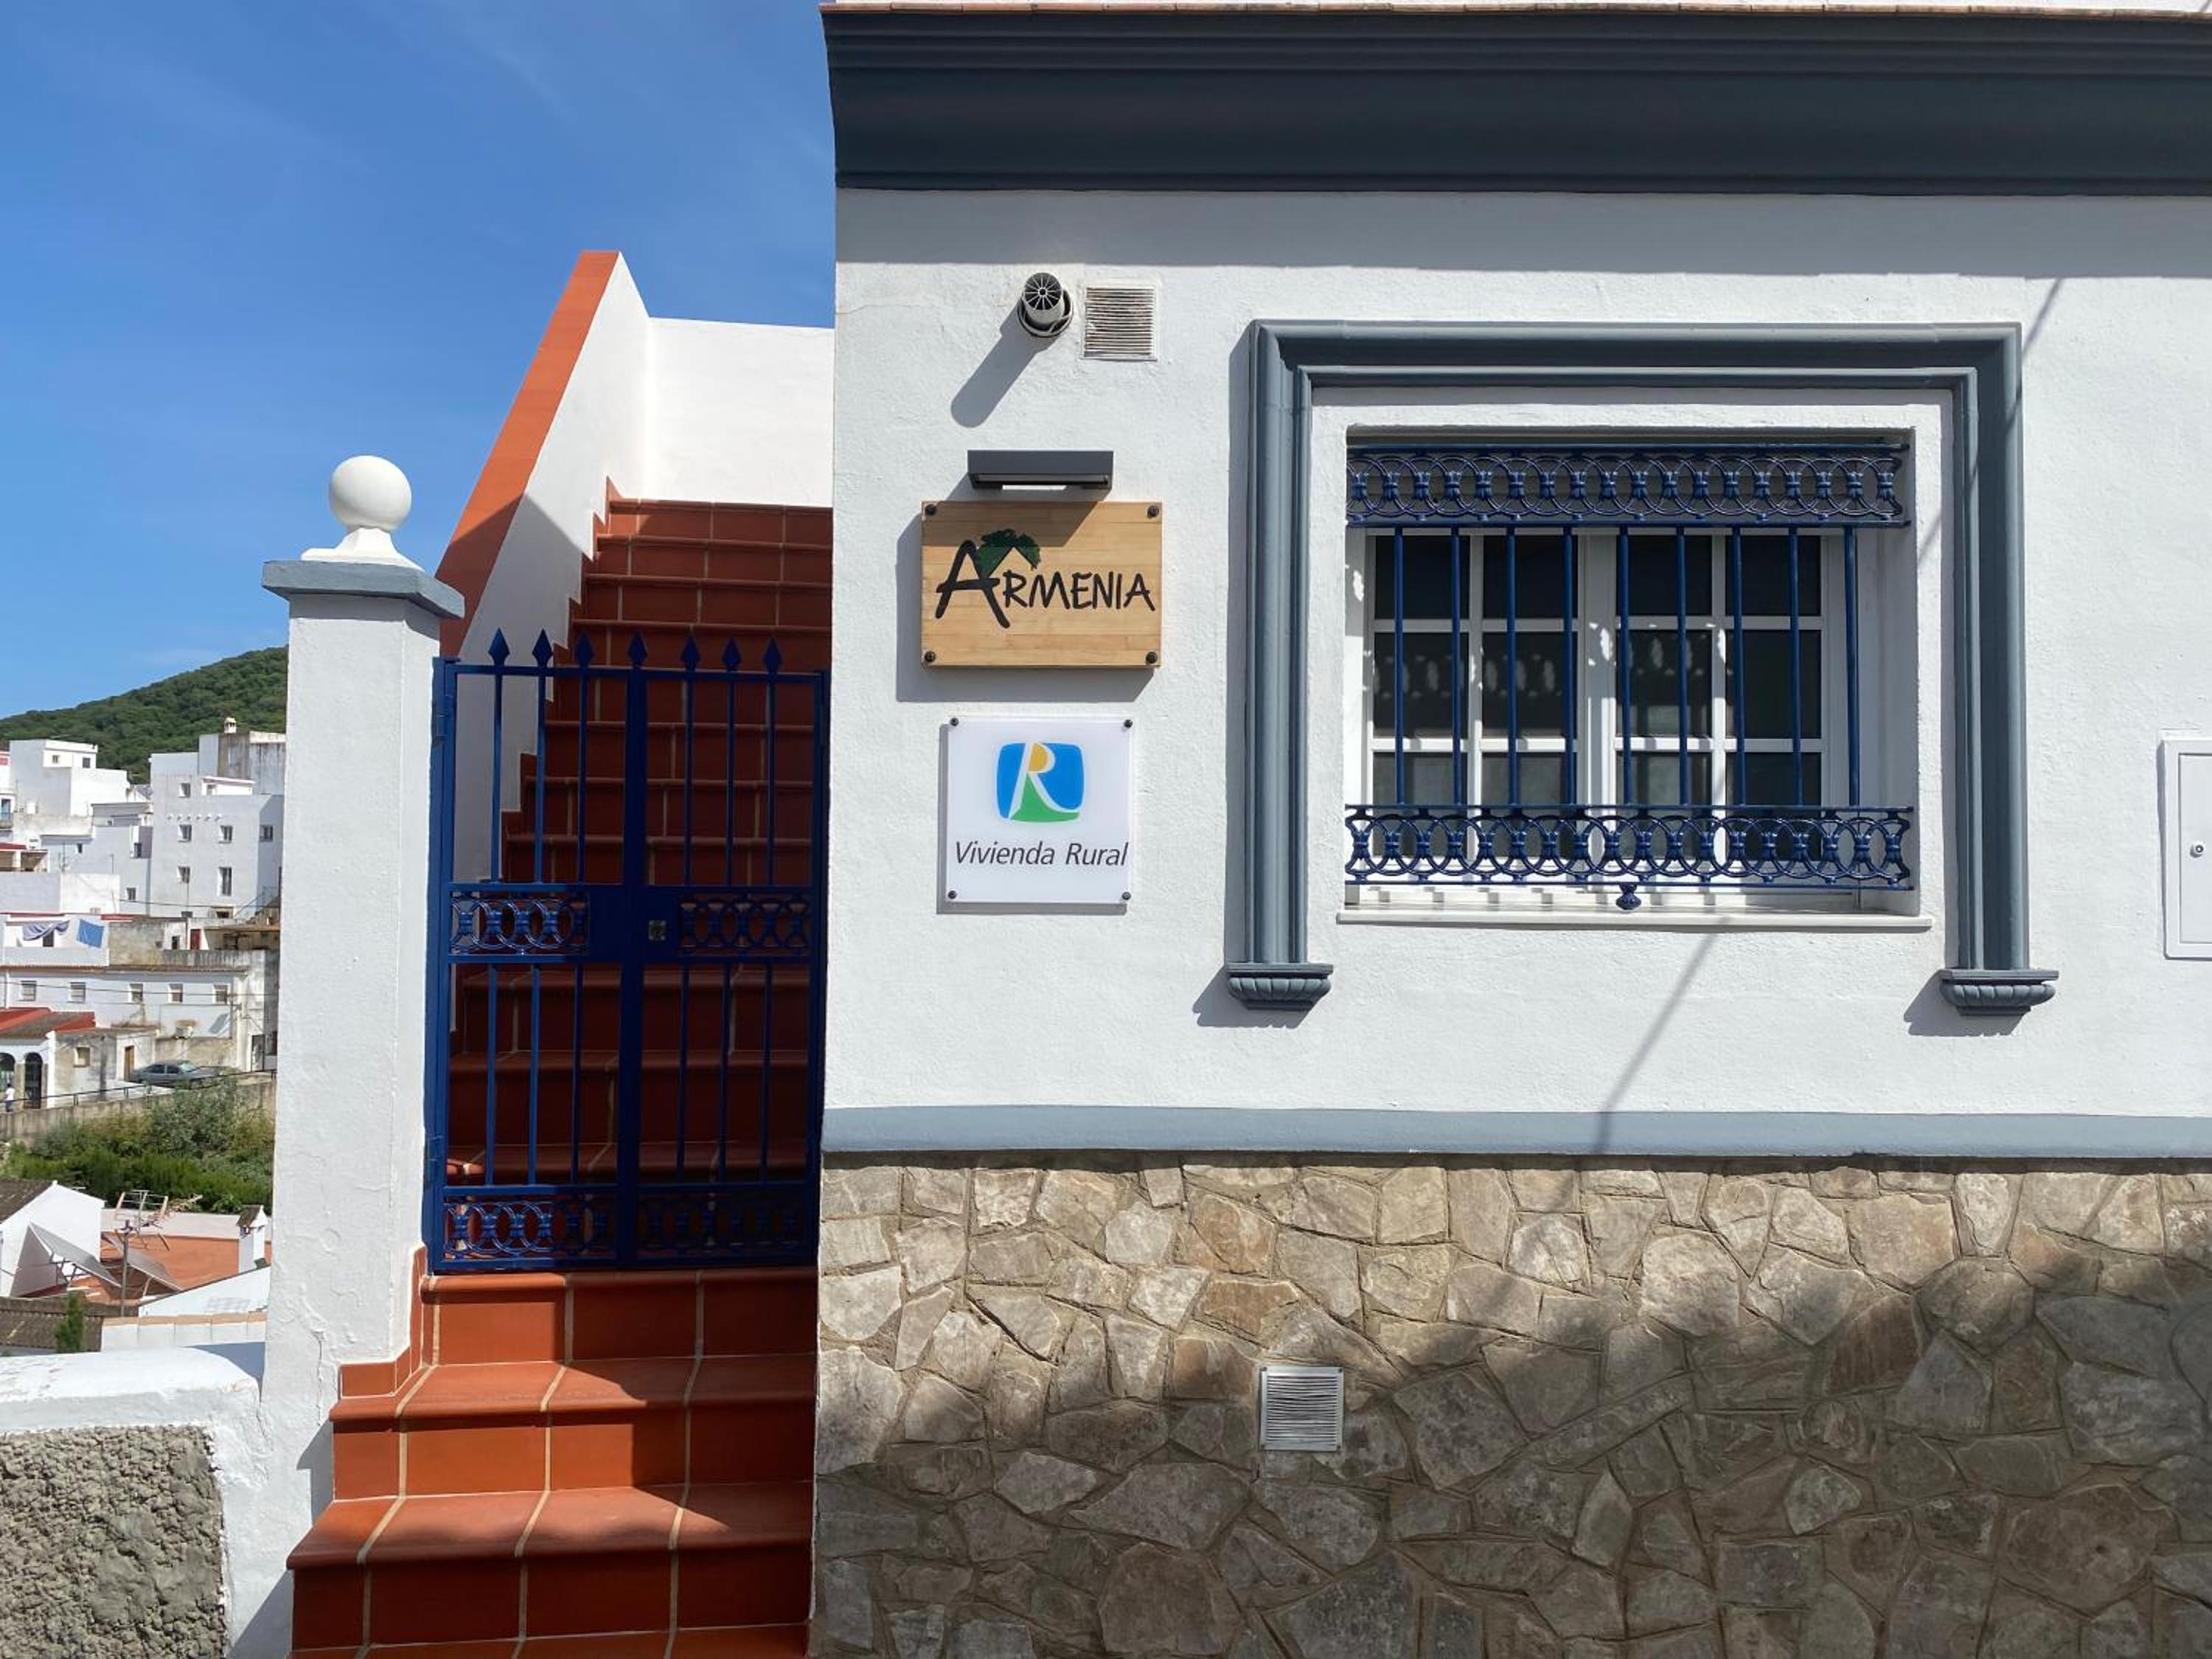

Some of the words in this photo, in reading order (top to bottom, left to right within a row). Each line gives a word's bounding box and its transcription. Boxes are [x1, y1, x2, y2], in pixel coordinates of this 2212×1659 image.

[936, 539, 1156, 629] ARMENIA
[956, 841, 1056, 865] Vivienda
[1065, 841, 1130, 866] Rural
